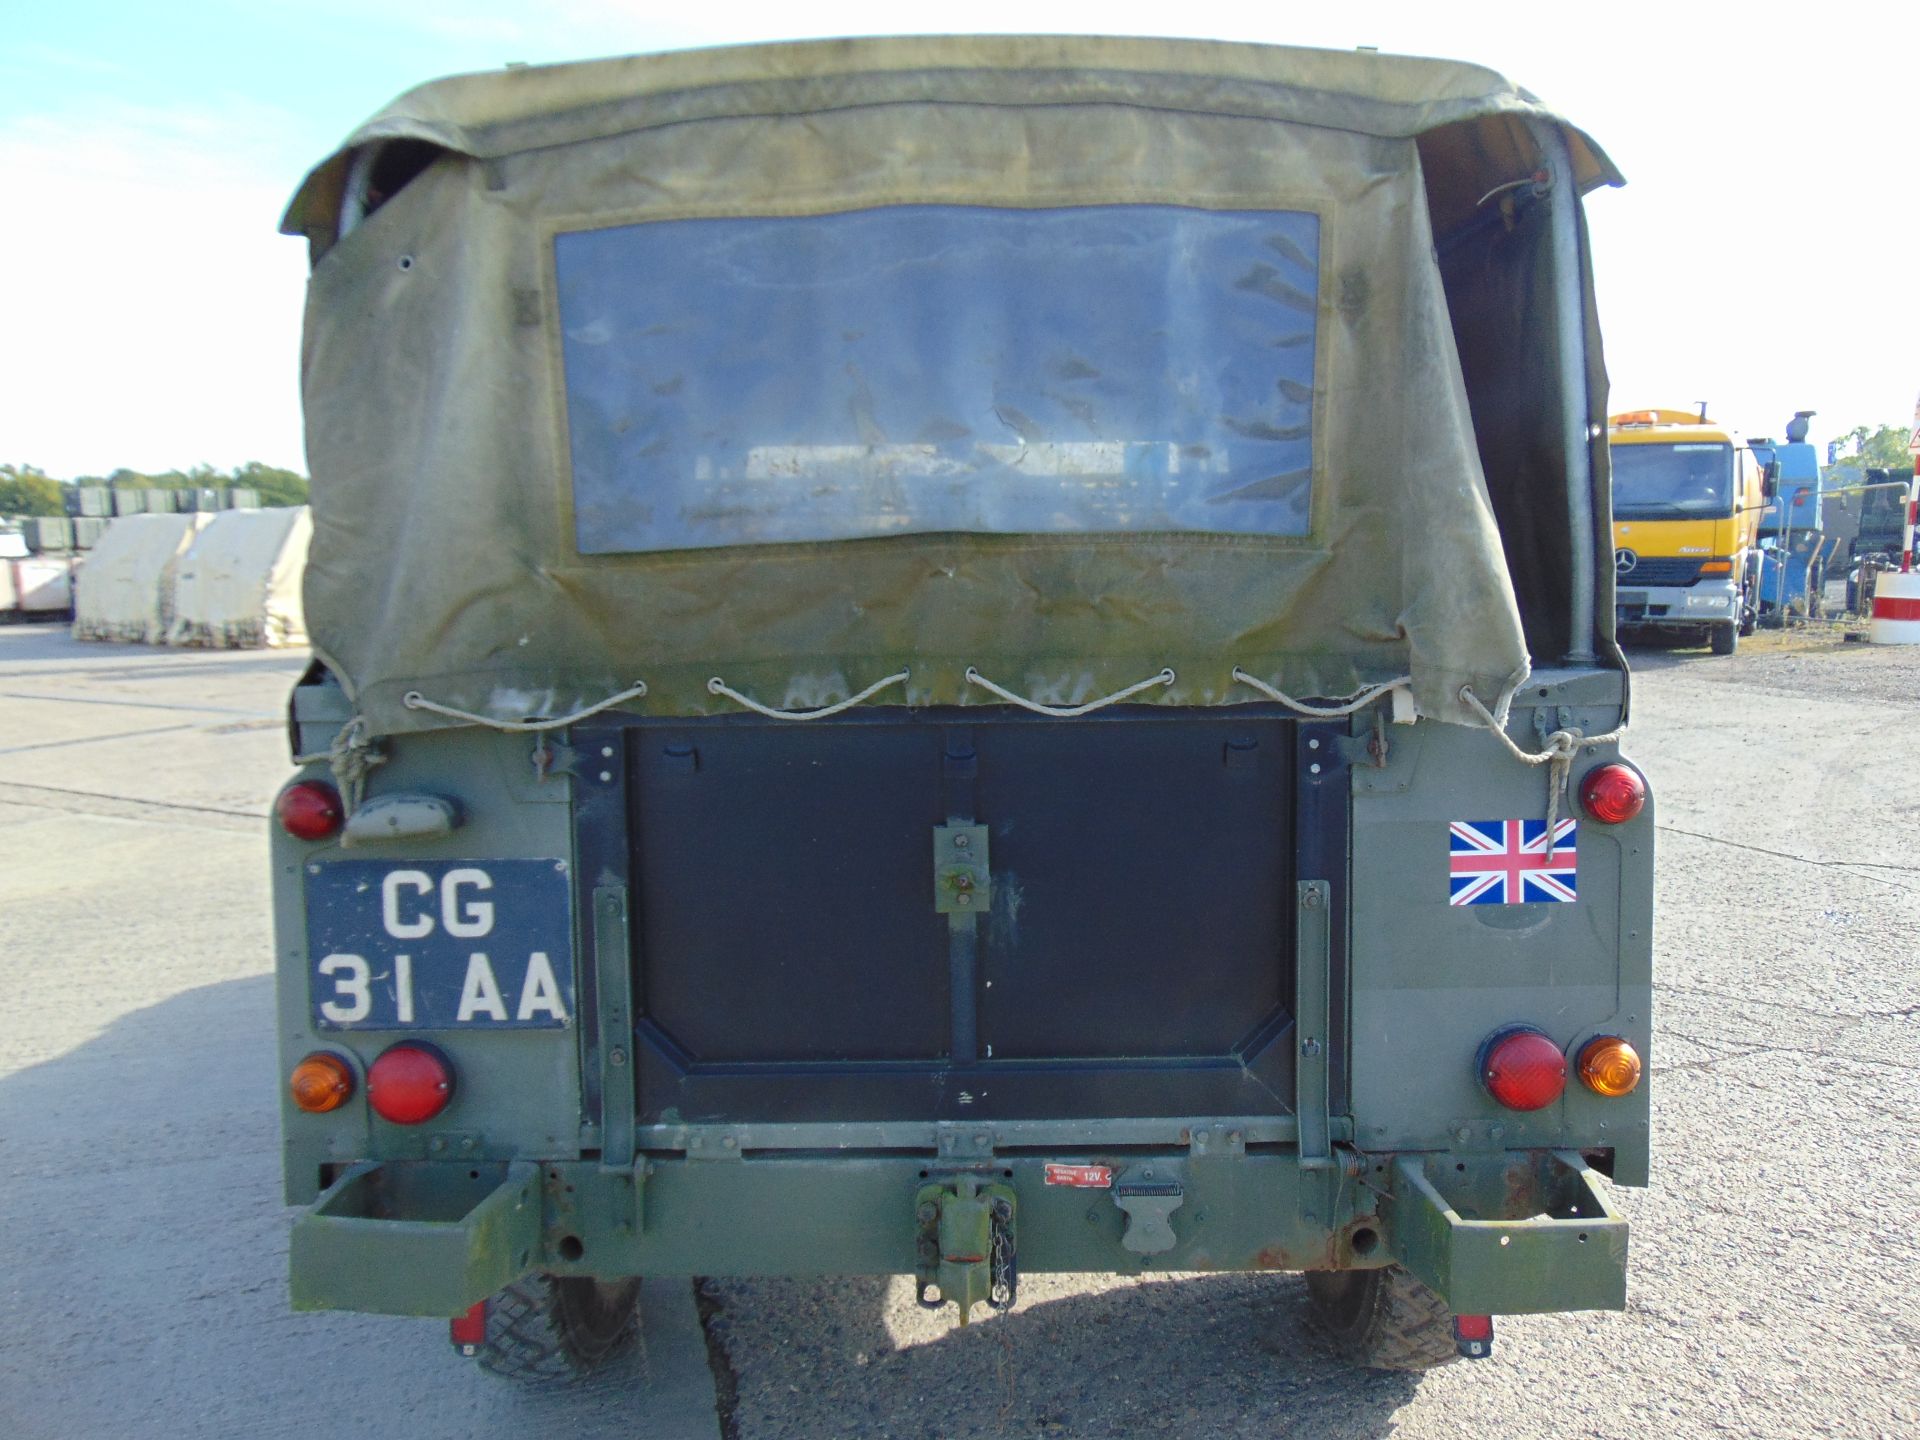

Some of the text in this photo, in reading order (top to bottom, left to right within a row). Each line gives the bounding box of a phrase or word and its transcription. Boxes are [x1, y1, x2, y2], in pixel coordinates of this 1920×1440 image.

[382, 868, 495, 939] CG
[318, 952, 567, 1022] 31 AA
